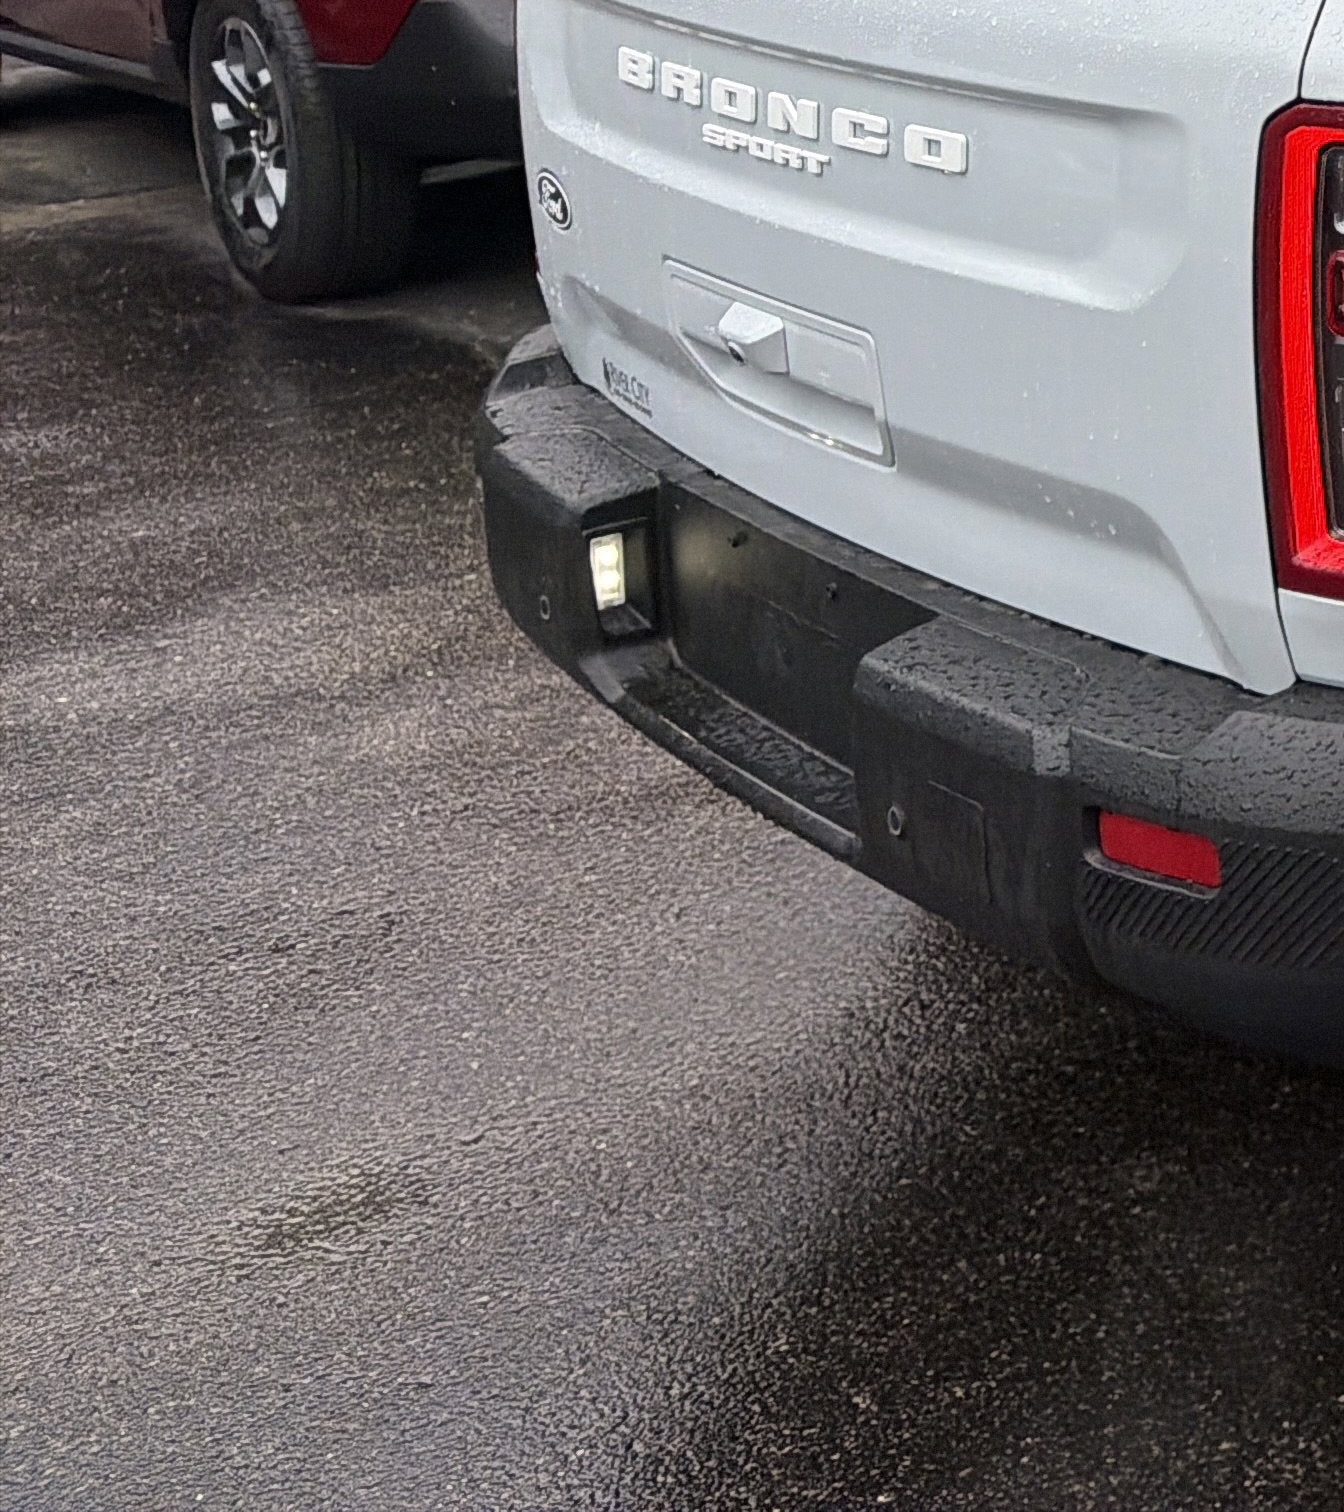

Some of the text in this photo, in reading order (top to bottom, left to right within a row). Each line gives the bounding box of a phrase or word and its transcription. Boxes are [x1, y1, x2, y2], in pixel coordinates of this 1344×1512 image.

[617, 45, 969, 173] BRONCO
[701, 122, 831, 175] SPORT
[540, 176, 566, 222] Ford
